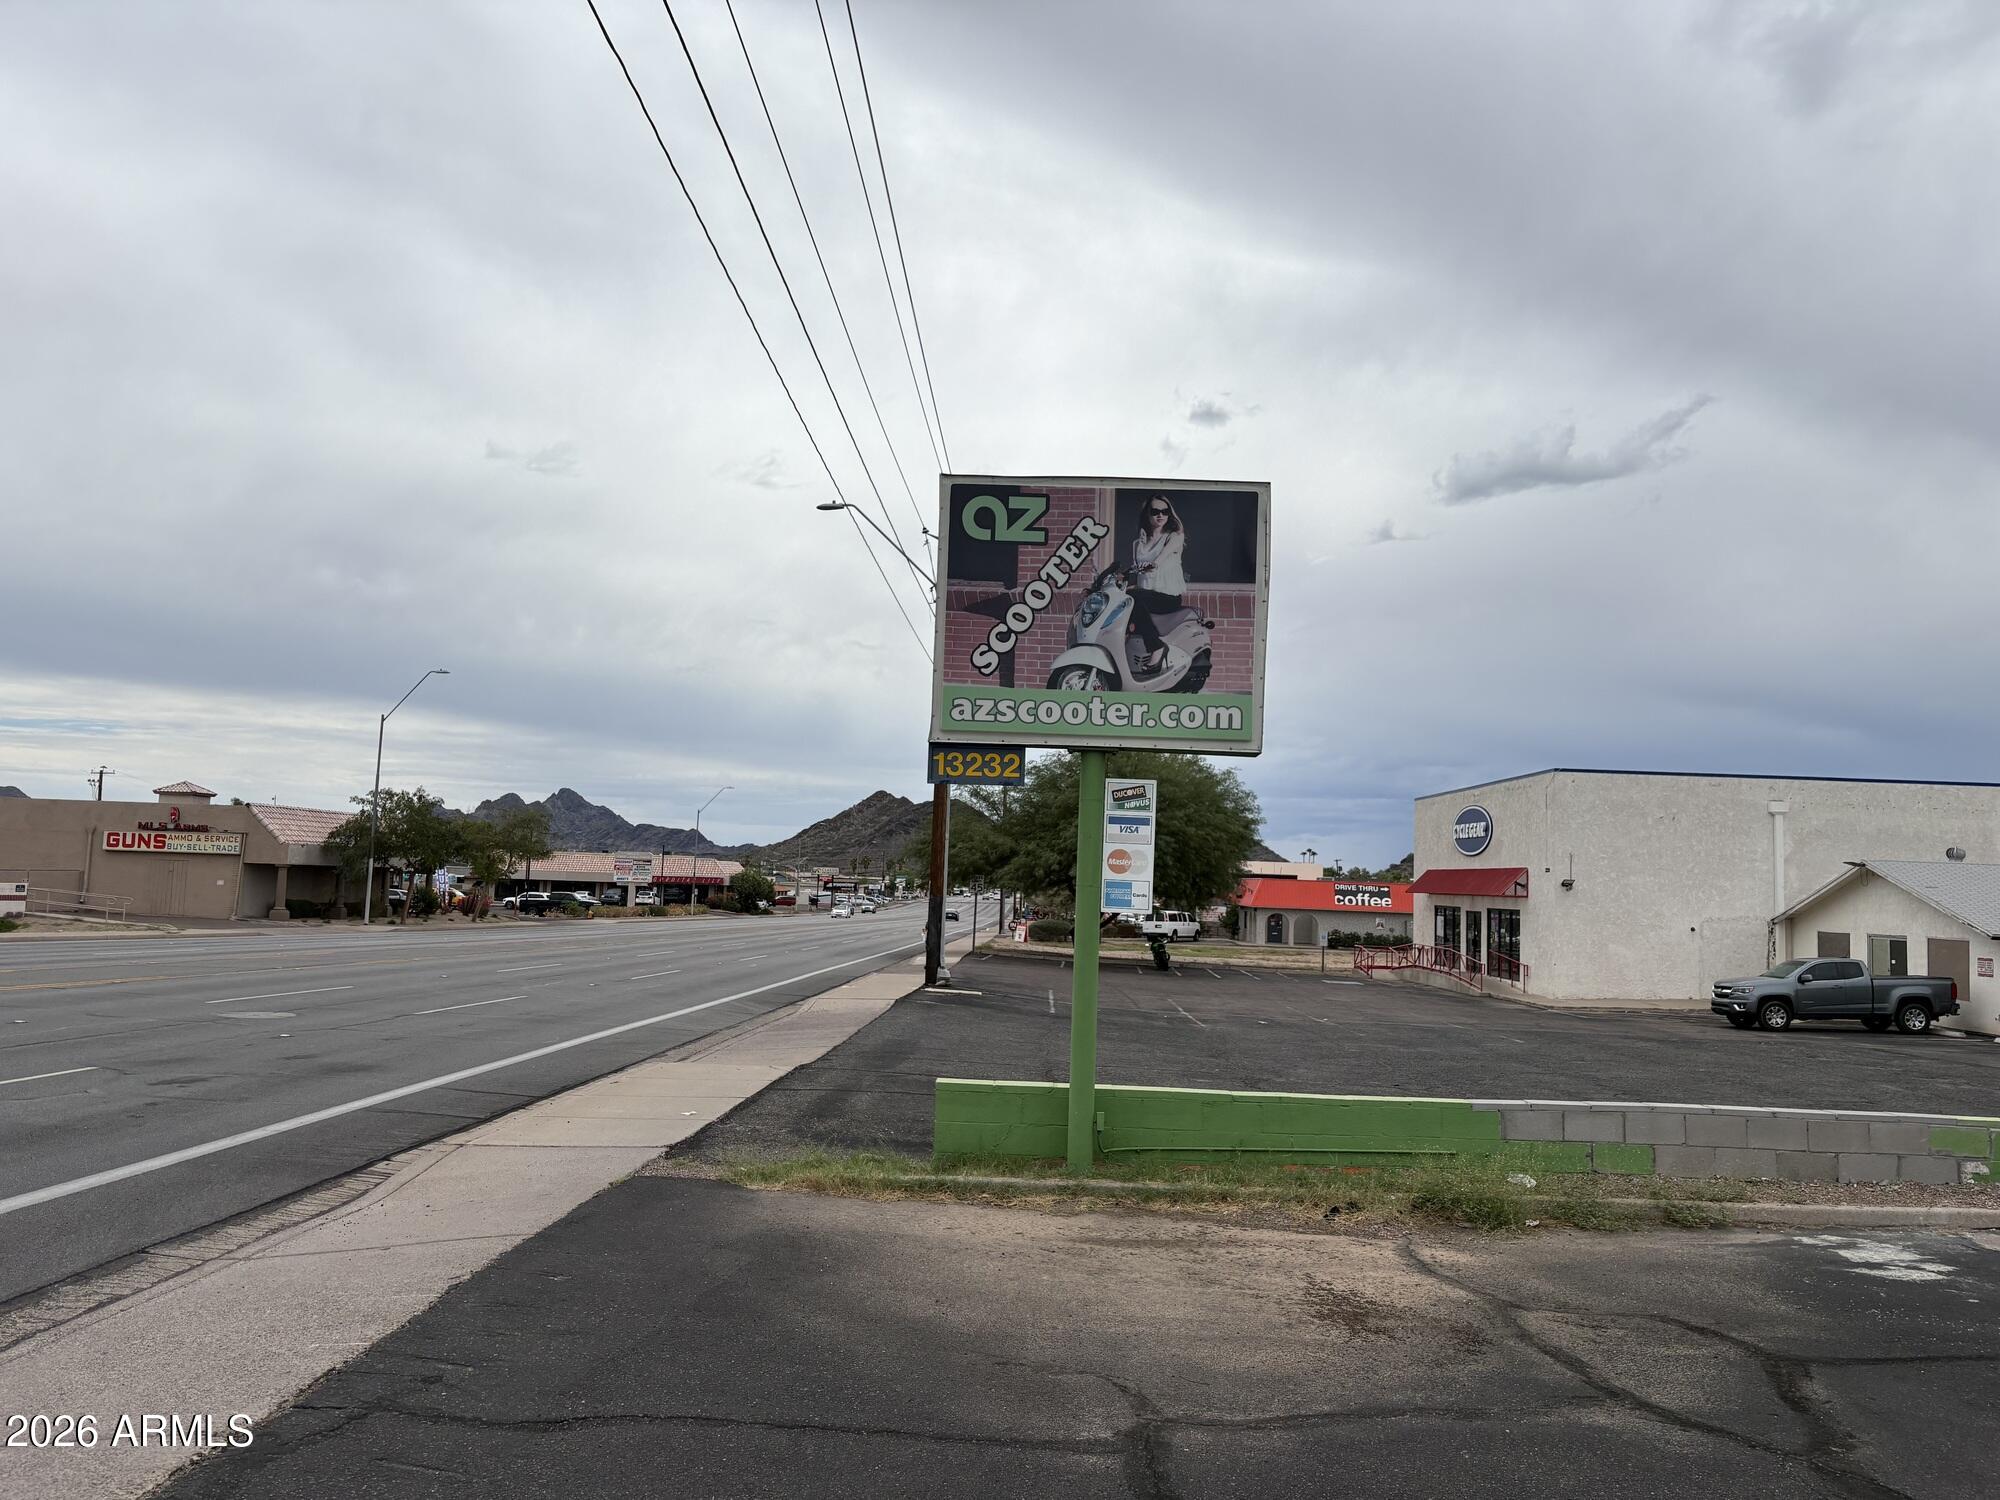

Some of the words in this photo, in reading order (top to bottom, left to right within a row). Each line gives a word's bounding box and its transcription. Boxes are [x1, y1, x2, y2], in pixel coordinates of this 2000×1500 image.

[961, 494, 1048, 543] az
[970, 516, 1109, 676] SCOOTER
[950, 696, 1244, 730] azscooter.com
[933, 752, 1020, 778] 13232
[1124, 798, 1150, 809] NOVUS
[1119, 825, 1139, 834] VISA
[106, 832, 168, 850] GUNS
[168, 834, 193, 842] AMMO
[204, 835, 240, 843] SERVICE
[1335, 883, 1357, 891] DRIVE
[1334, 893, 1392, 908] coffee
